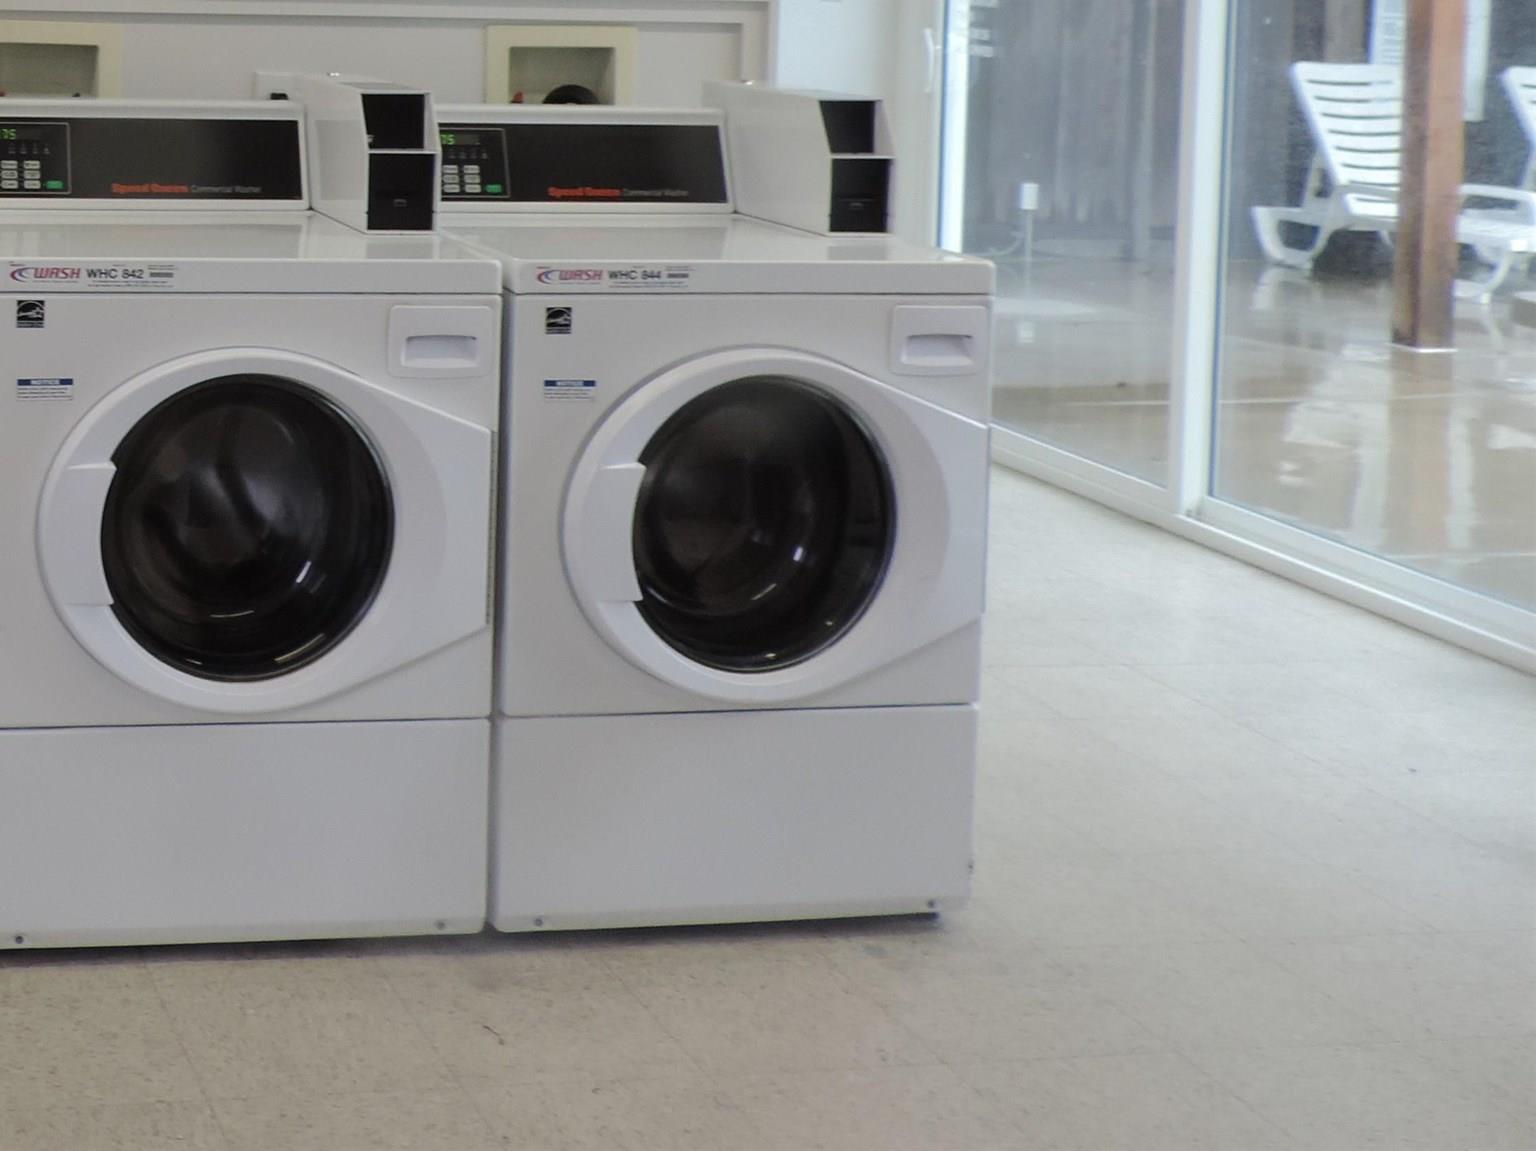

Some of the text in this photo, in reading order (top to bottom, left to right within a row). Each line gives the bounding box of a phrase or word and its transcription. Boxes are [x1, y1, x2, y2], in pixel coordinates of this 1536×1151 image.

[33, 267, 81, 279] WASH
[85, 268, 118, 279] WHC
[559, 269, 603, 281] WASH
[608, 270, 638, 280] WHC
